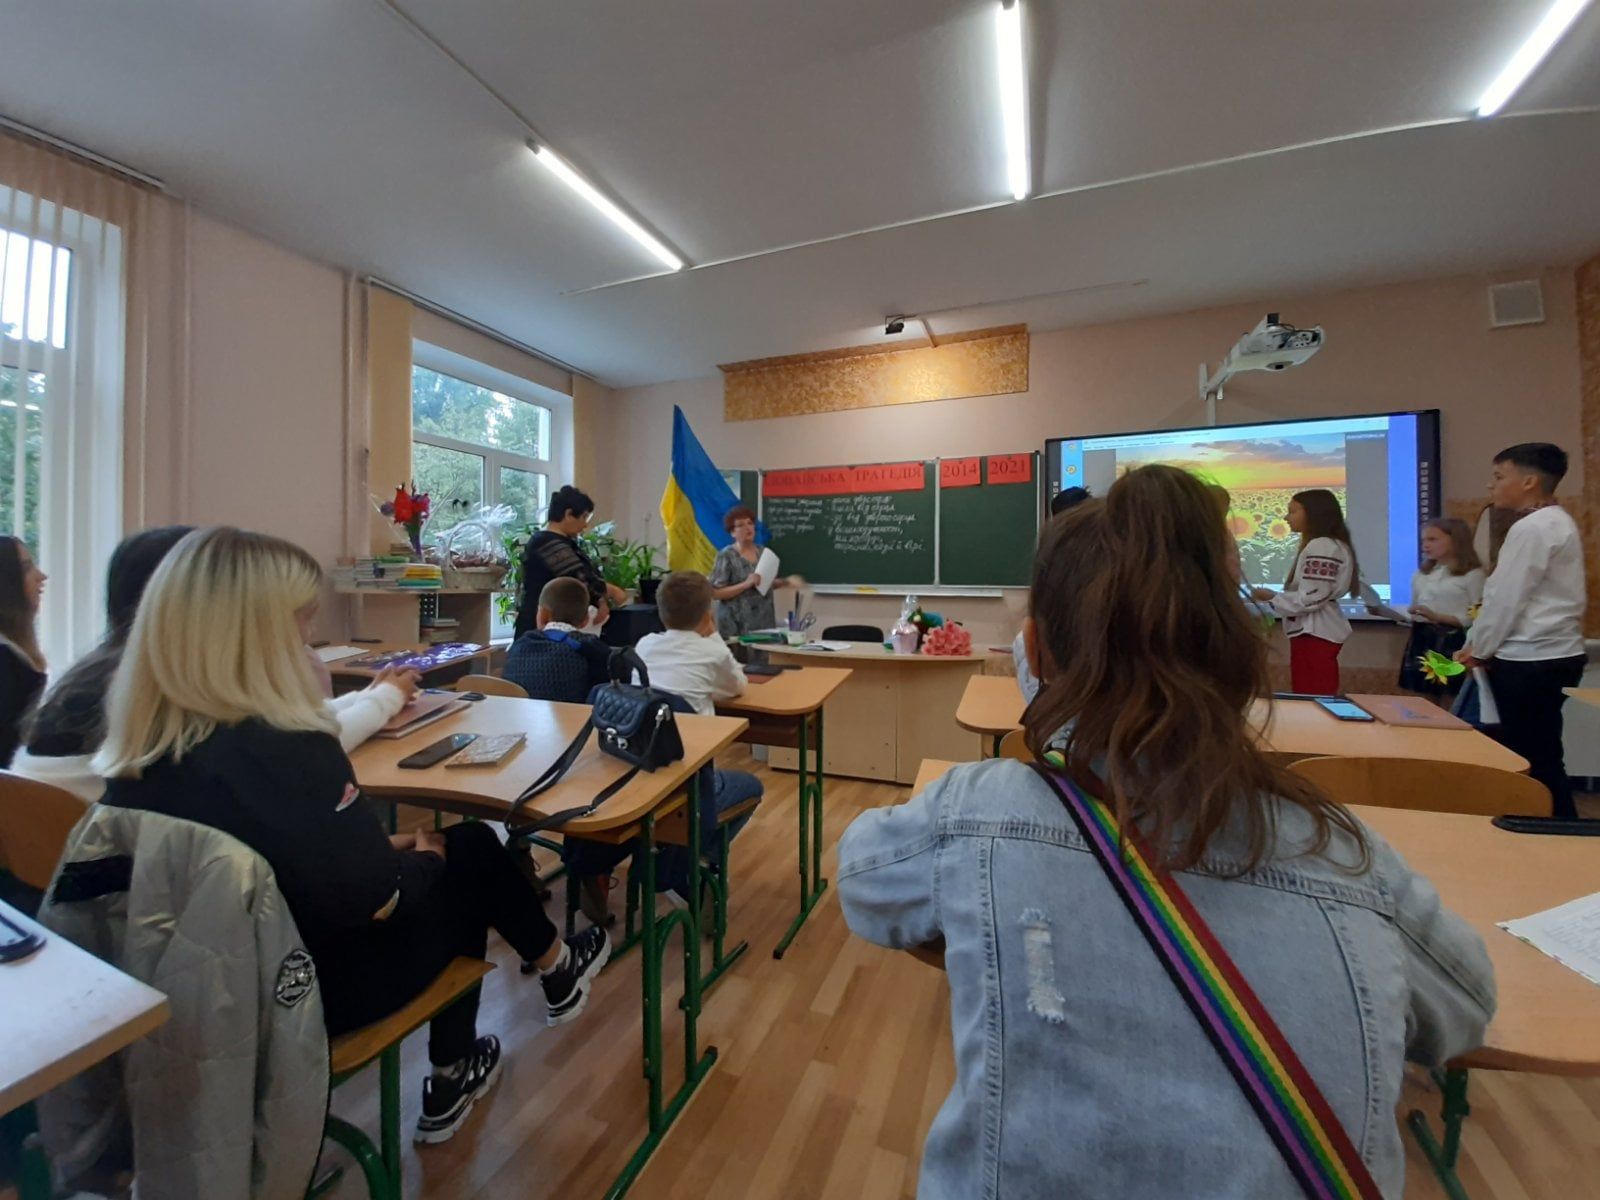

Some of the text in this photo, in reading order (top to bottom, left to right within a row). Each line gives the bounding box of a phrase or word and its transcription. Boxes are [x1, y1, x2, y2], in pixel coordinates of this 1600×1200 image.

[855, 467, 921, 481] ТРАГЕДІЯ
[943, 462, 977, 478] 2014
[989, 459, 1026, 475] 2021
